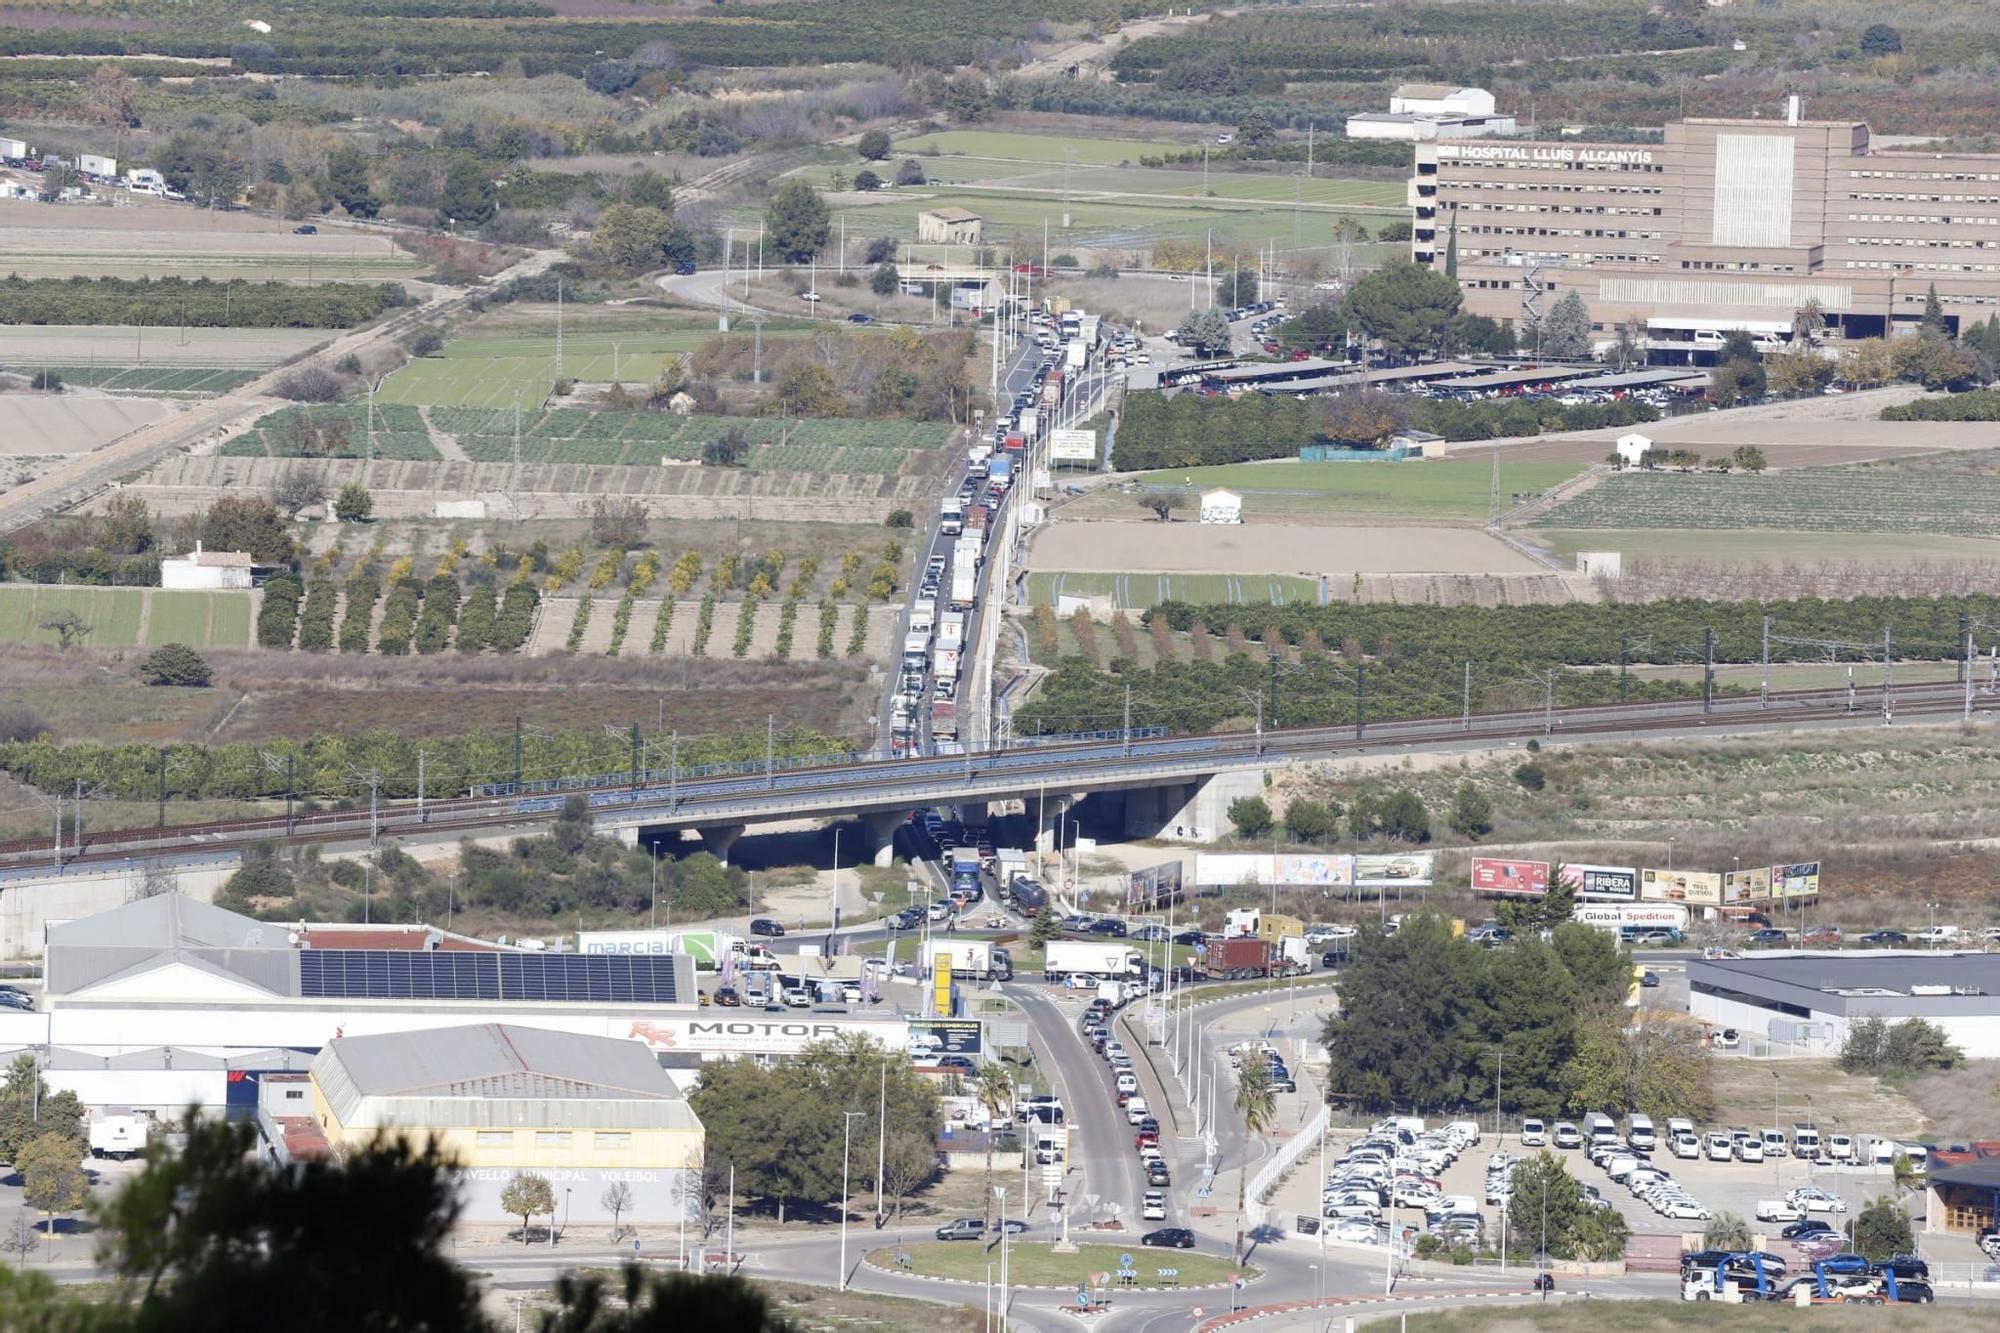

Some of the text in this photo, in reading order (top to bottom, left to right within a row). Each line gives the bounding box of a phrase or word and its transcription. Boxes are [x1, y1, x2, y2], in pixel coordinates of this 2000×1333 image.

[1461, 145, 1530, 160] HOSPITAL
[1595, 877, 1631, 888] RIBERA
[1585, 912, 1675, 921] Global Spedition
[689, 1022, 840, 1037] MOTOR
[600, 1171, 660, 1182] VOLEIBOL
